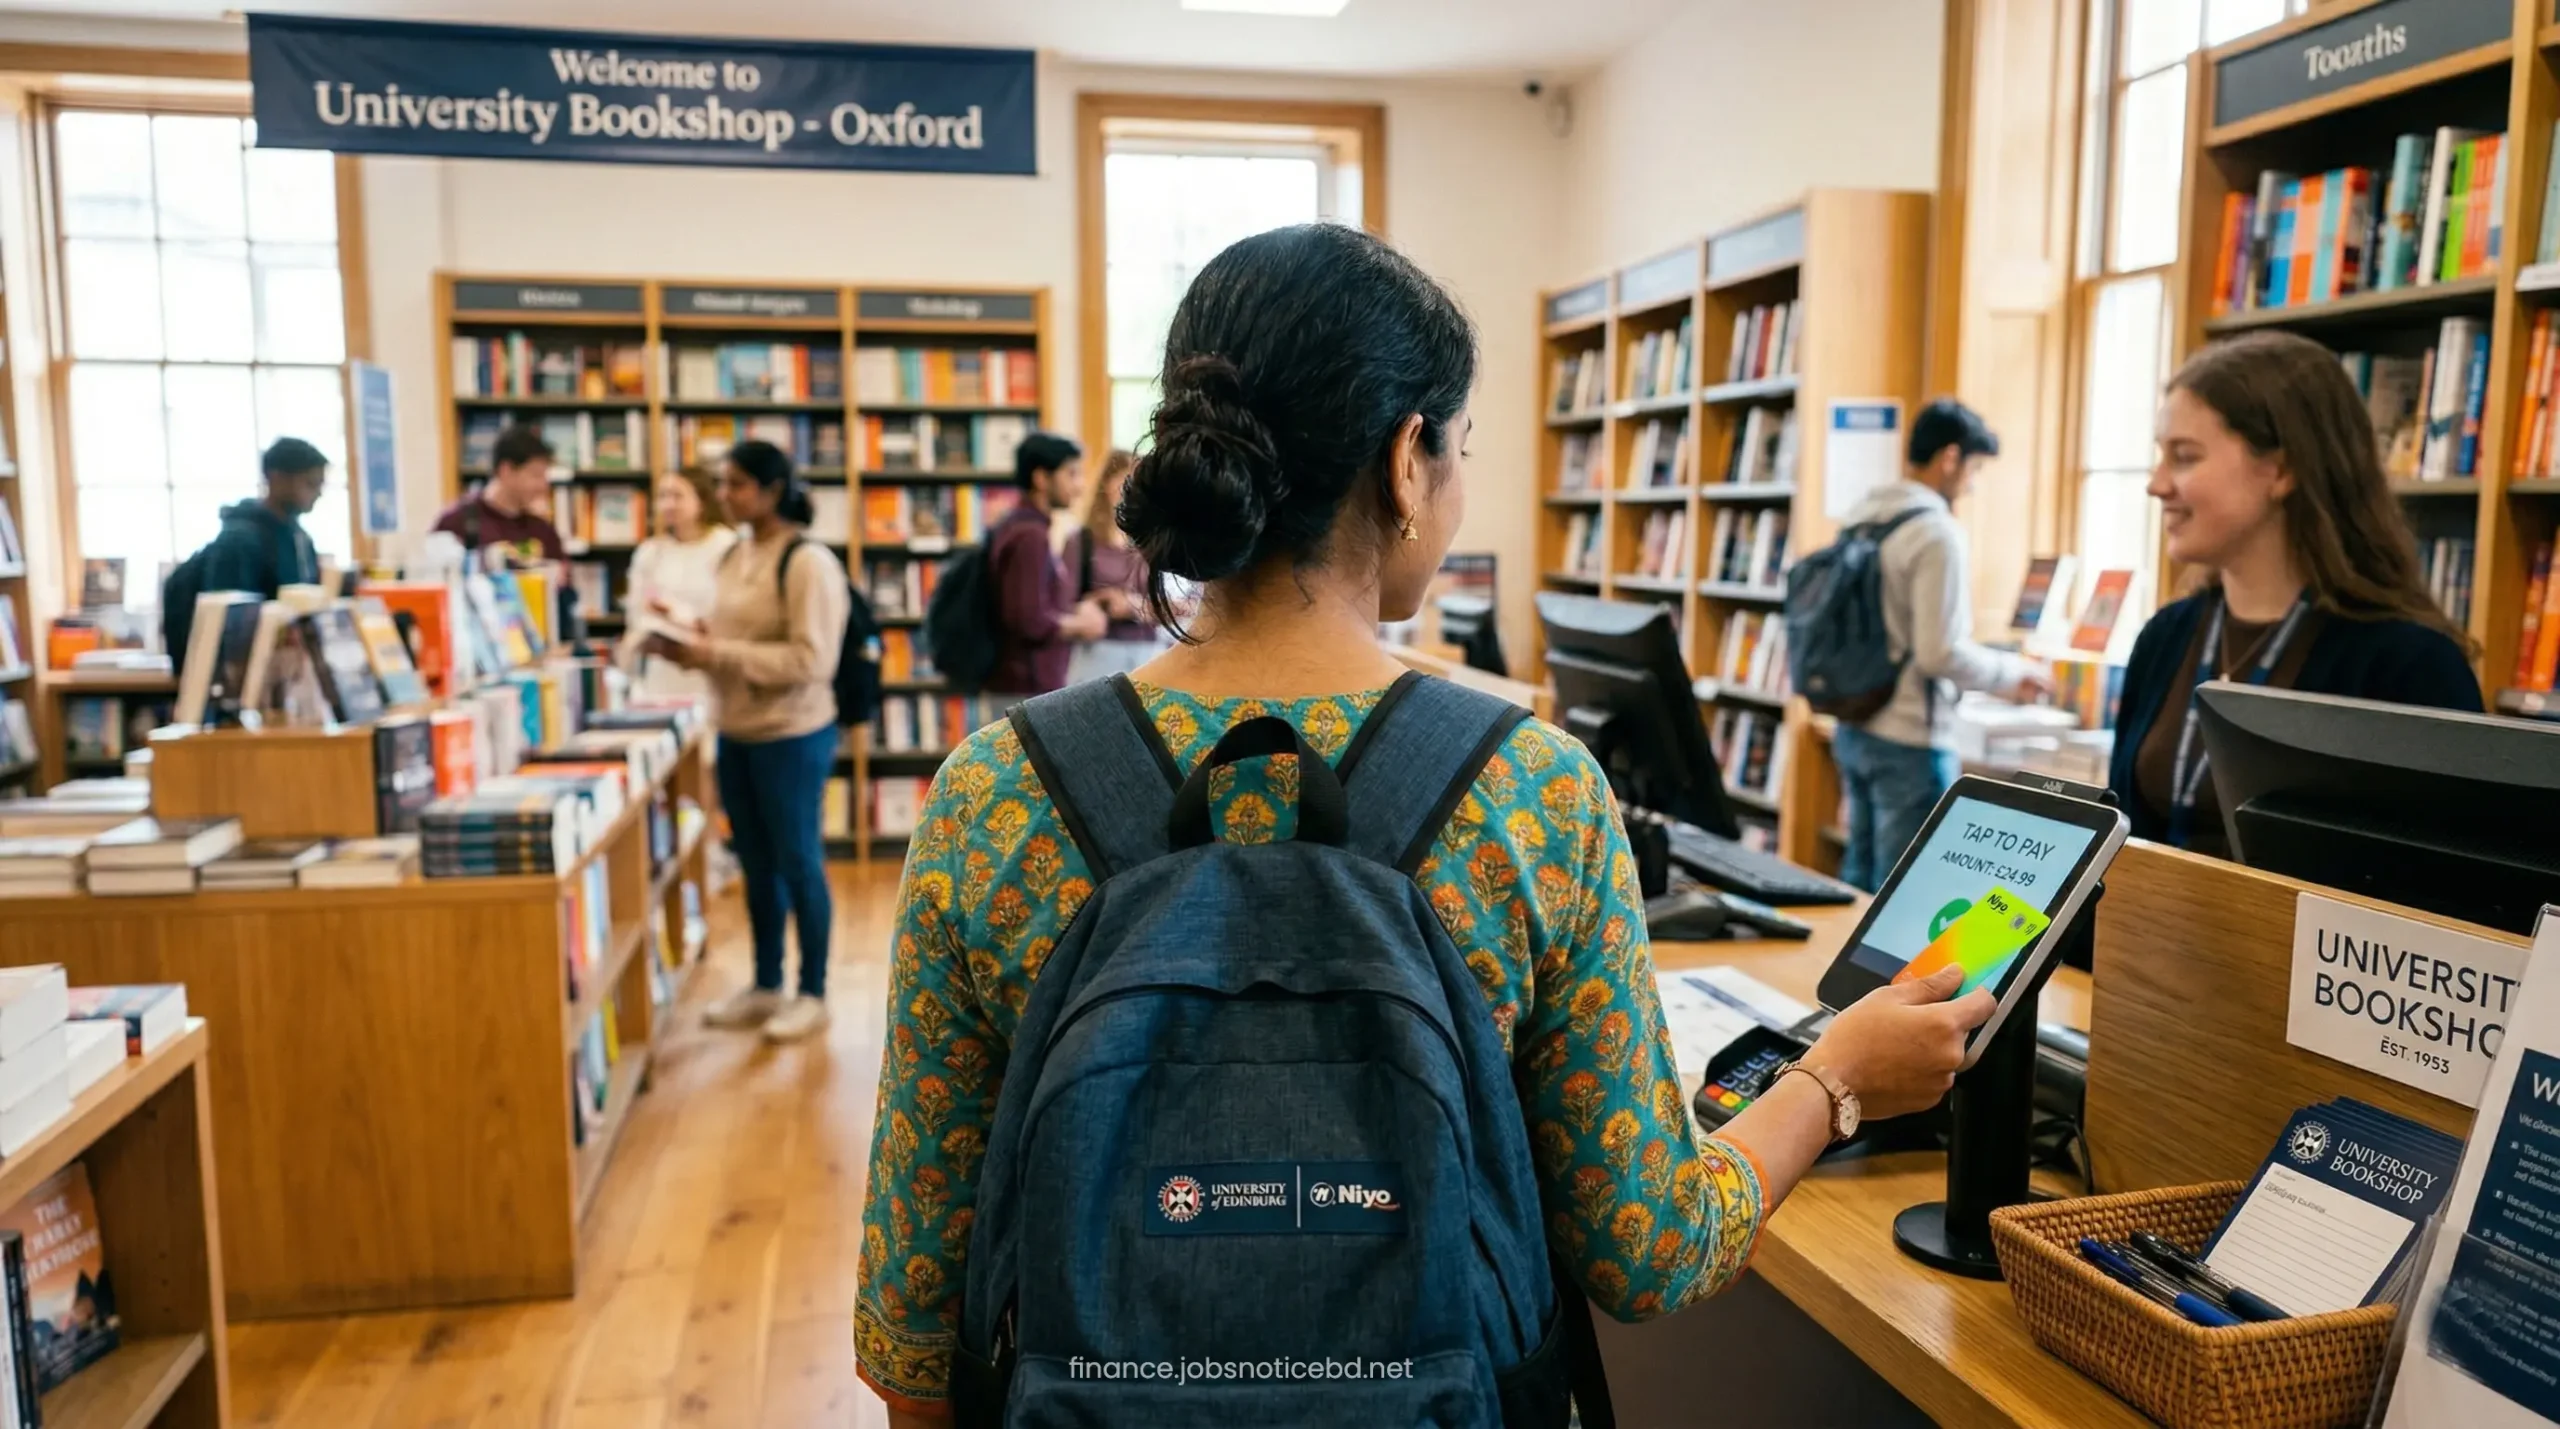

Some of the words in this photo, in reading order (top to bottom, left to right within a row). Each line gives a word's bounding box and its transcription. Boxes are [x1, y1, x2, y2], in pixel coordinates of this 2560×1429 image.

[550, 48, 716, 90] Welcome
[723, 60, 760, 92] to
[314, 81, 558, 144] University
[568, 93, 795, 151] Bookshop
[802, 119, 822, 132] -
[830, 101, 984, 149] Oxford
[1963, 822, 1995, 843] TAP
[1994, 831, 2018, 851] TO
[2018, 838, 2056, 861] PAY
[1940, 850, 1995, 875] AMOUNT:
[1994, 865, 2036, 887] £24.99
[2317, 929, 2521, 1012] UNIVERSIT
[2414, 1051, 2450, 1074] 1953
[2329, 1155, 2424, 1204] BOOKSHOP
[2338, 1138, 2439, 1189] UNIVERSITY
[1211, 1183, 1286, 1195] UNIVERSITY
[1338, 1185, 1391, 1208] Niyo
